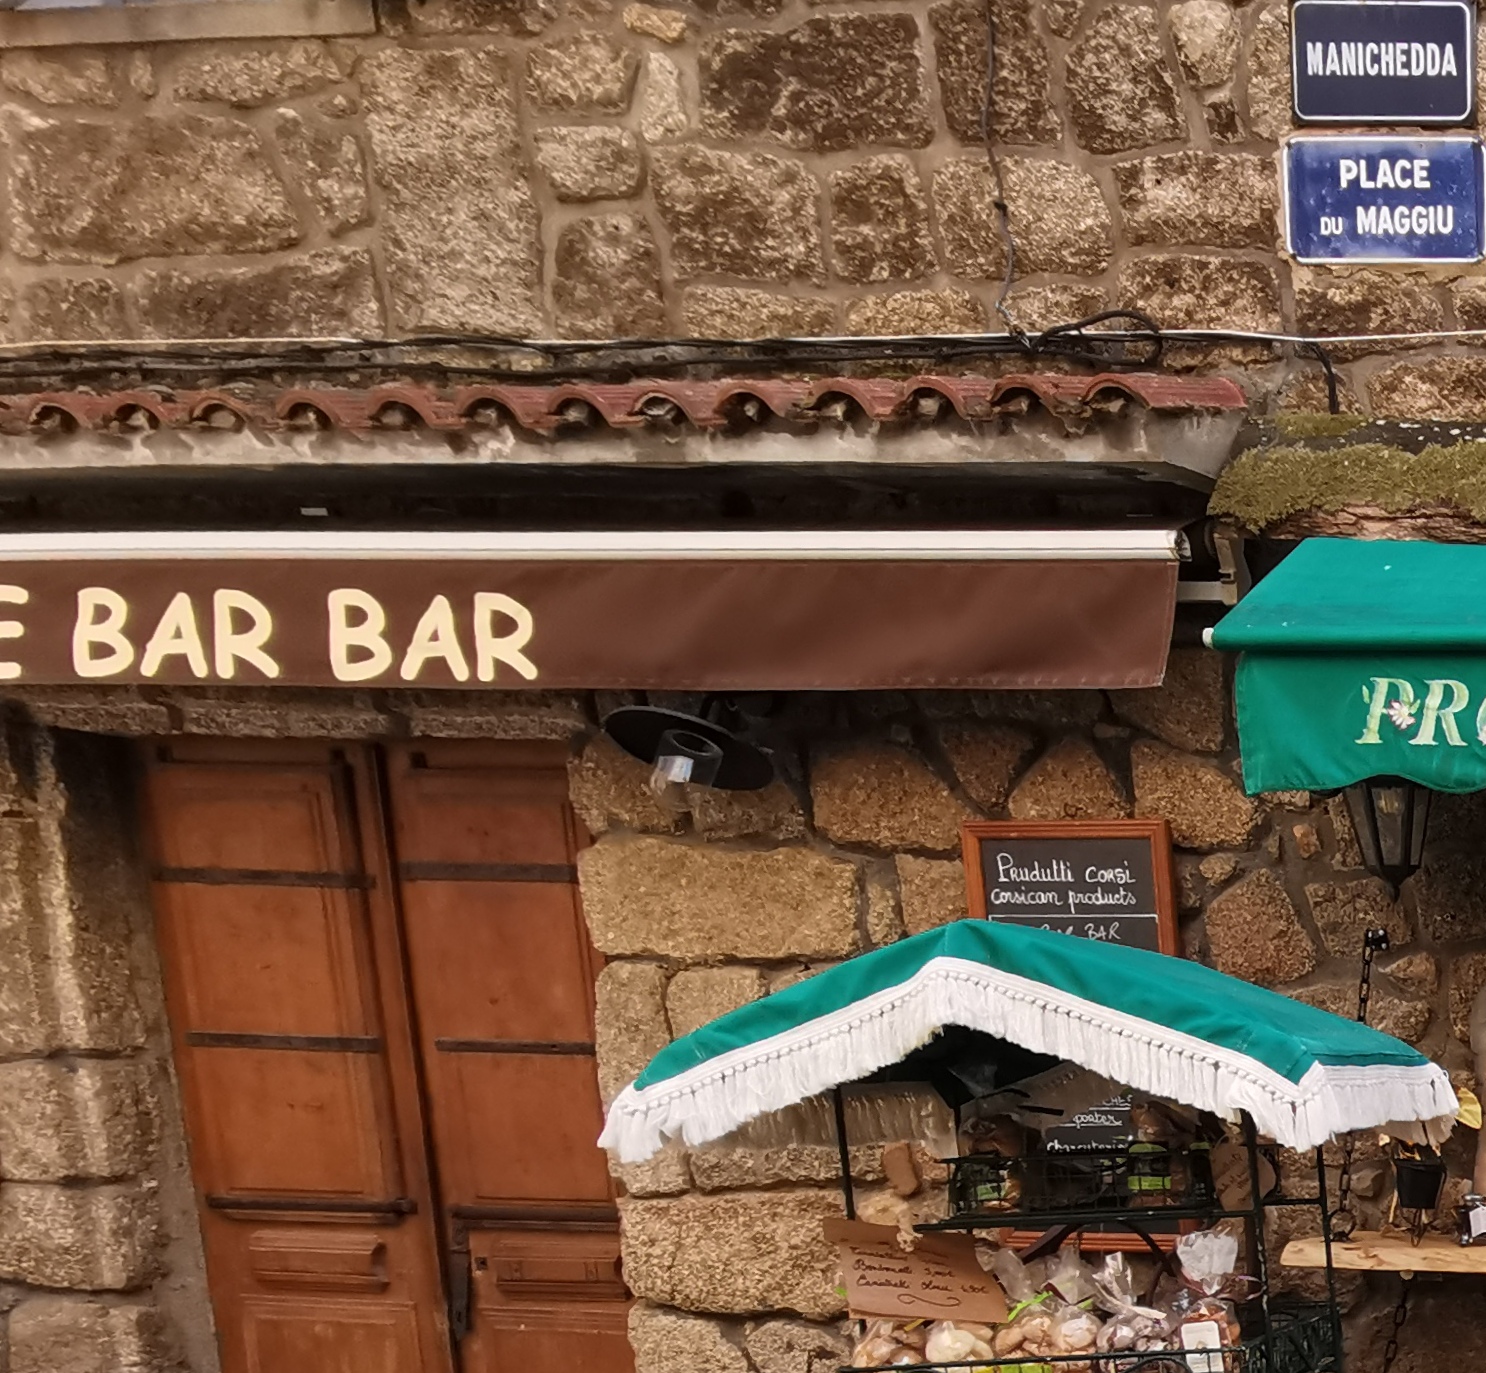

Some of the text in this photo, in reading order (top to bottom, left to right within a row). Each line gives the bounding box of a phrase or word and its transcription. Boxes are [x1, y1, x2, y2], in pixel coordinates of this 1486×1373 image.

[1306, 42, 1457, 76] MANICHEDDA
[1339, 159, 1431, 188] PLACE
[1320, 205, 1453, 235] DU MAGGIU
[72, 587, 280, 679] BAR
[327, 588, 538, 681] BAR
[996, 852, 1075, 882] Prudutti
[991, 886, 1137, 914] corsican products
